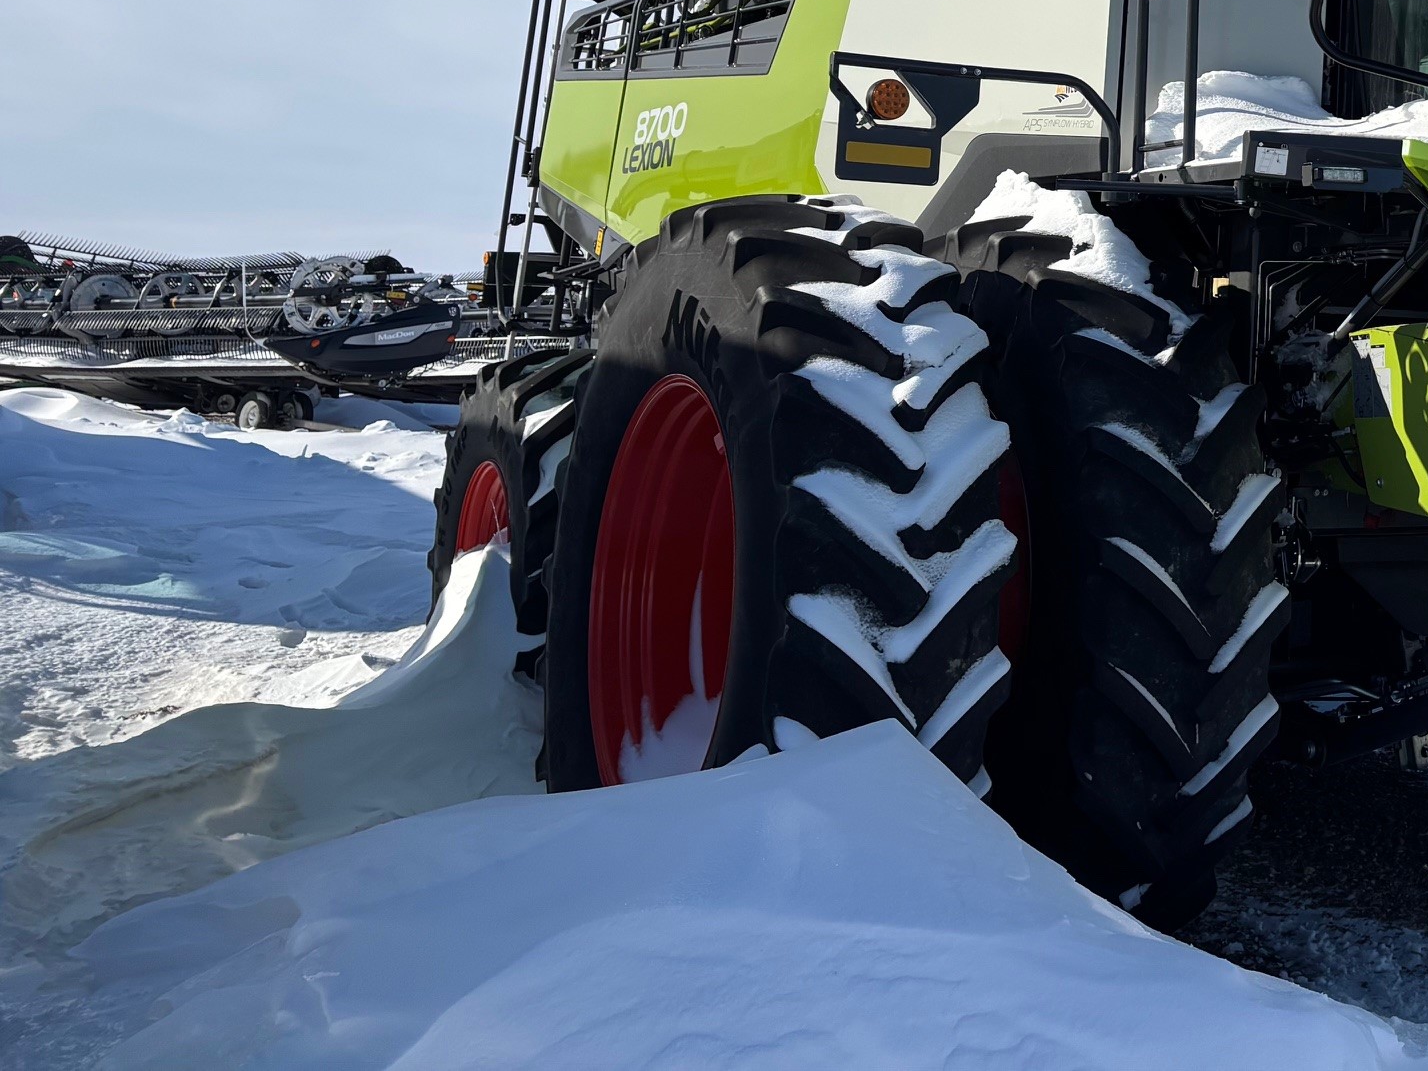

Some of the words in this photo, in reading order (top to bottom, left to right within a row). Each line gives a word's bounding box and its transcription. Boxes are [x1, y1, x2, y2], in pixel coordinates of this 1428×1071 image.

[634, 101, 688, 145] 8700
[1022, 118, 1043, 132] APS
[1073, 119, 1095, 129] HYBRID
[622, 138, 676, 174] LEXION
[377, 330, 415, 341] MacDon
